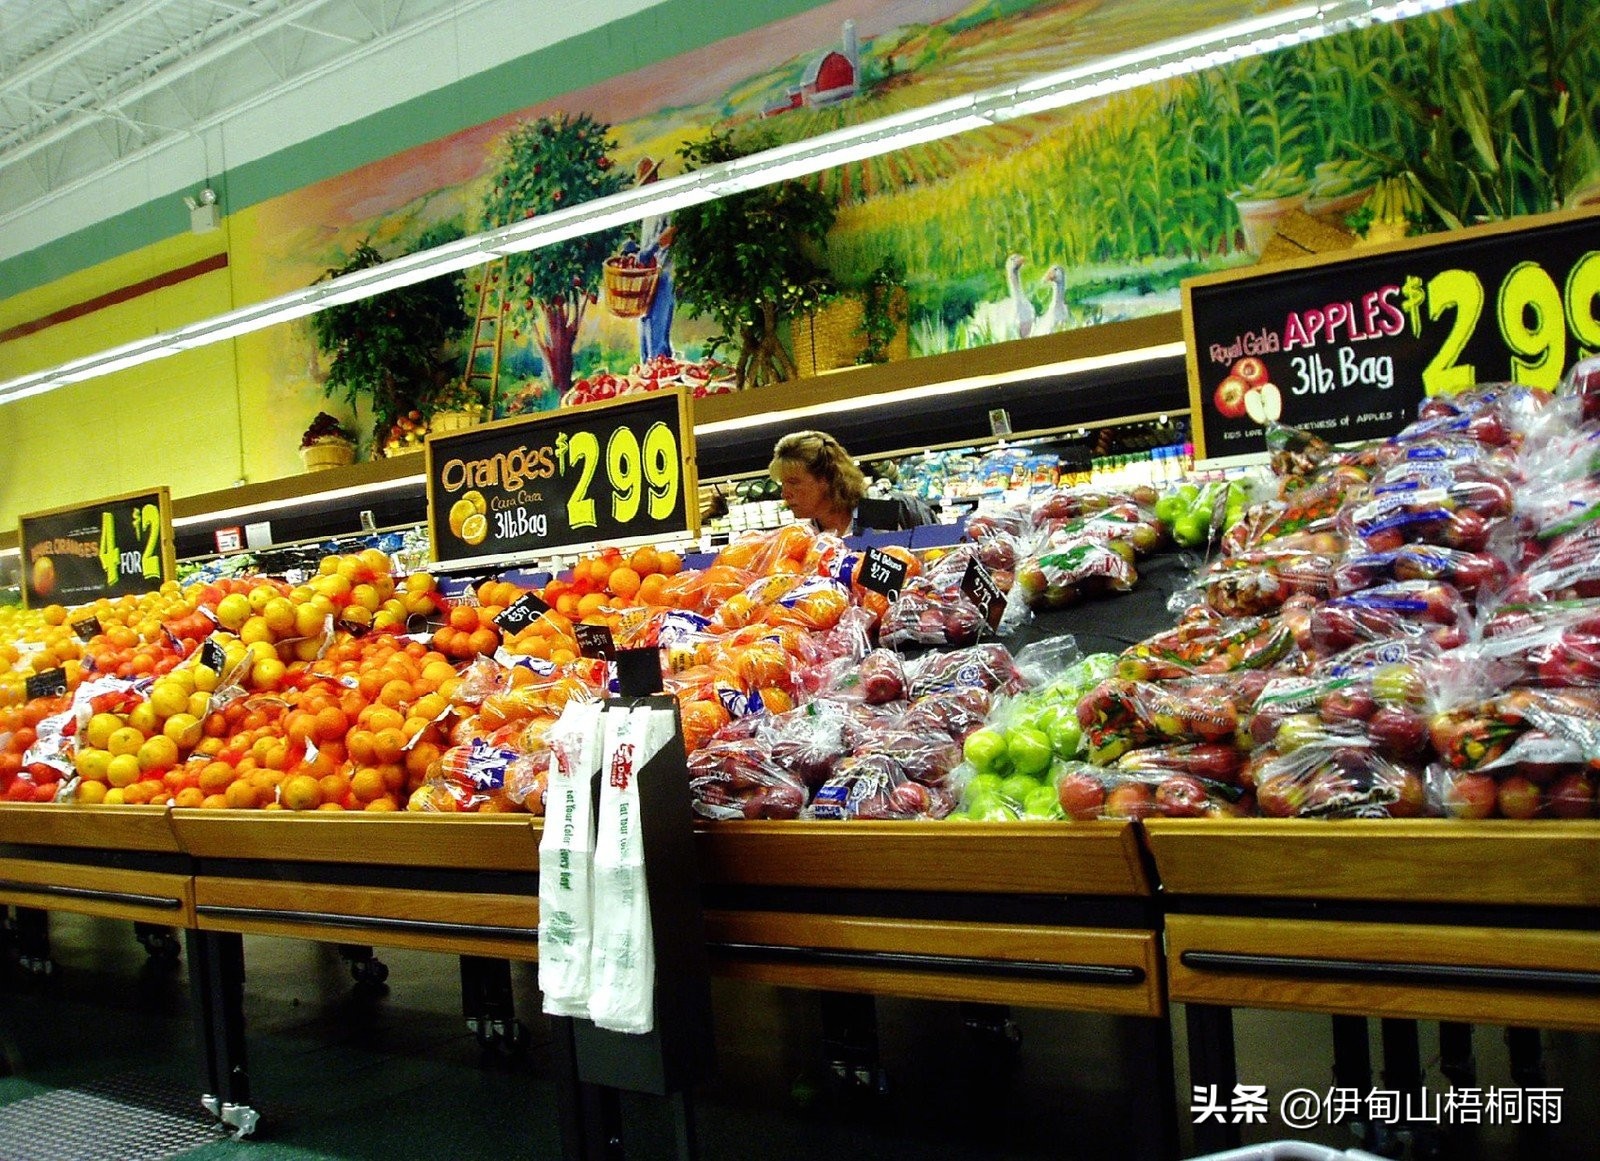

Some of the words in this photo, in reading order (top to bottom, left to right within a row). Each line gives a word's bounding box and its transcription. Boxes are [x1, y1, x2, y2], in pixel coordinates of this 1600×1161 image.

[1210, 337, 1243, 366] Royal
[1242, 328, 1280, 356] Gala
[1283, 285, 1405, 351] APPLES
[1290, 353, 1336, 395] 3lb.
[1338, 346, 1395, 390] Bag
[1340, 415, 1350, 426] of
[1356, 411, 1393, 424] APPLES
[441, 446, 556, 492] Oranges
[490, 495, 518, 512] Cara
[517, 489, 545, 505] Cara
[99, 511, 121, 587] 4
[120, 550, 143, 575] FOR
[620, 802, 629, 816] Eat
